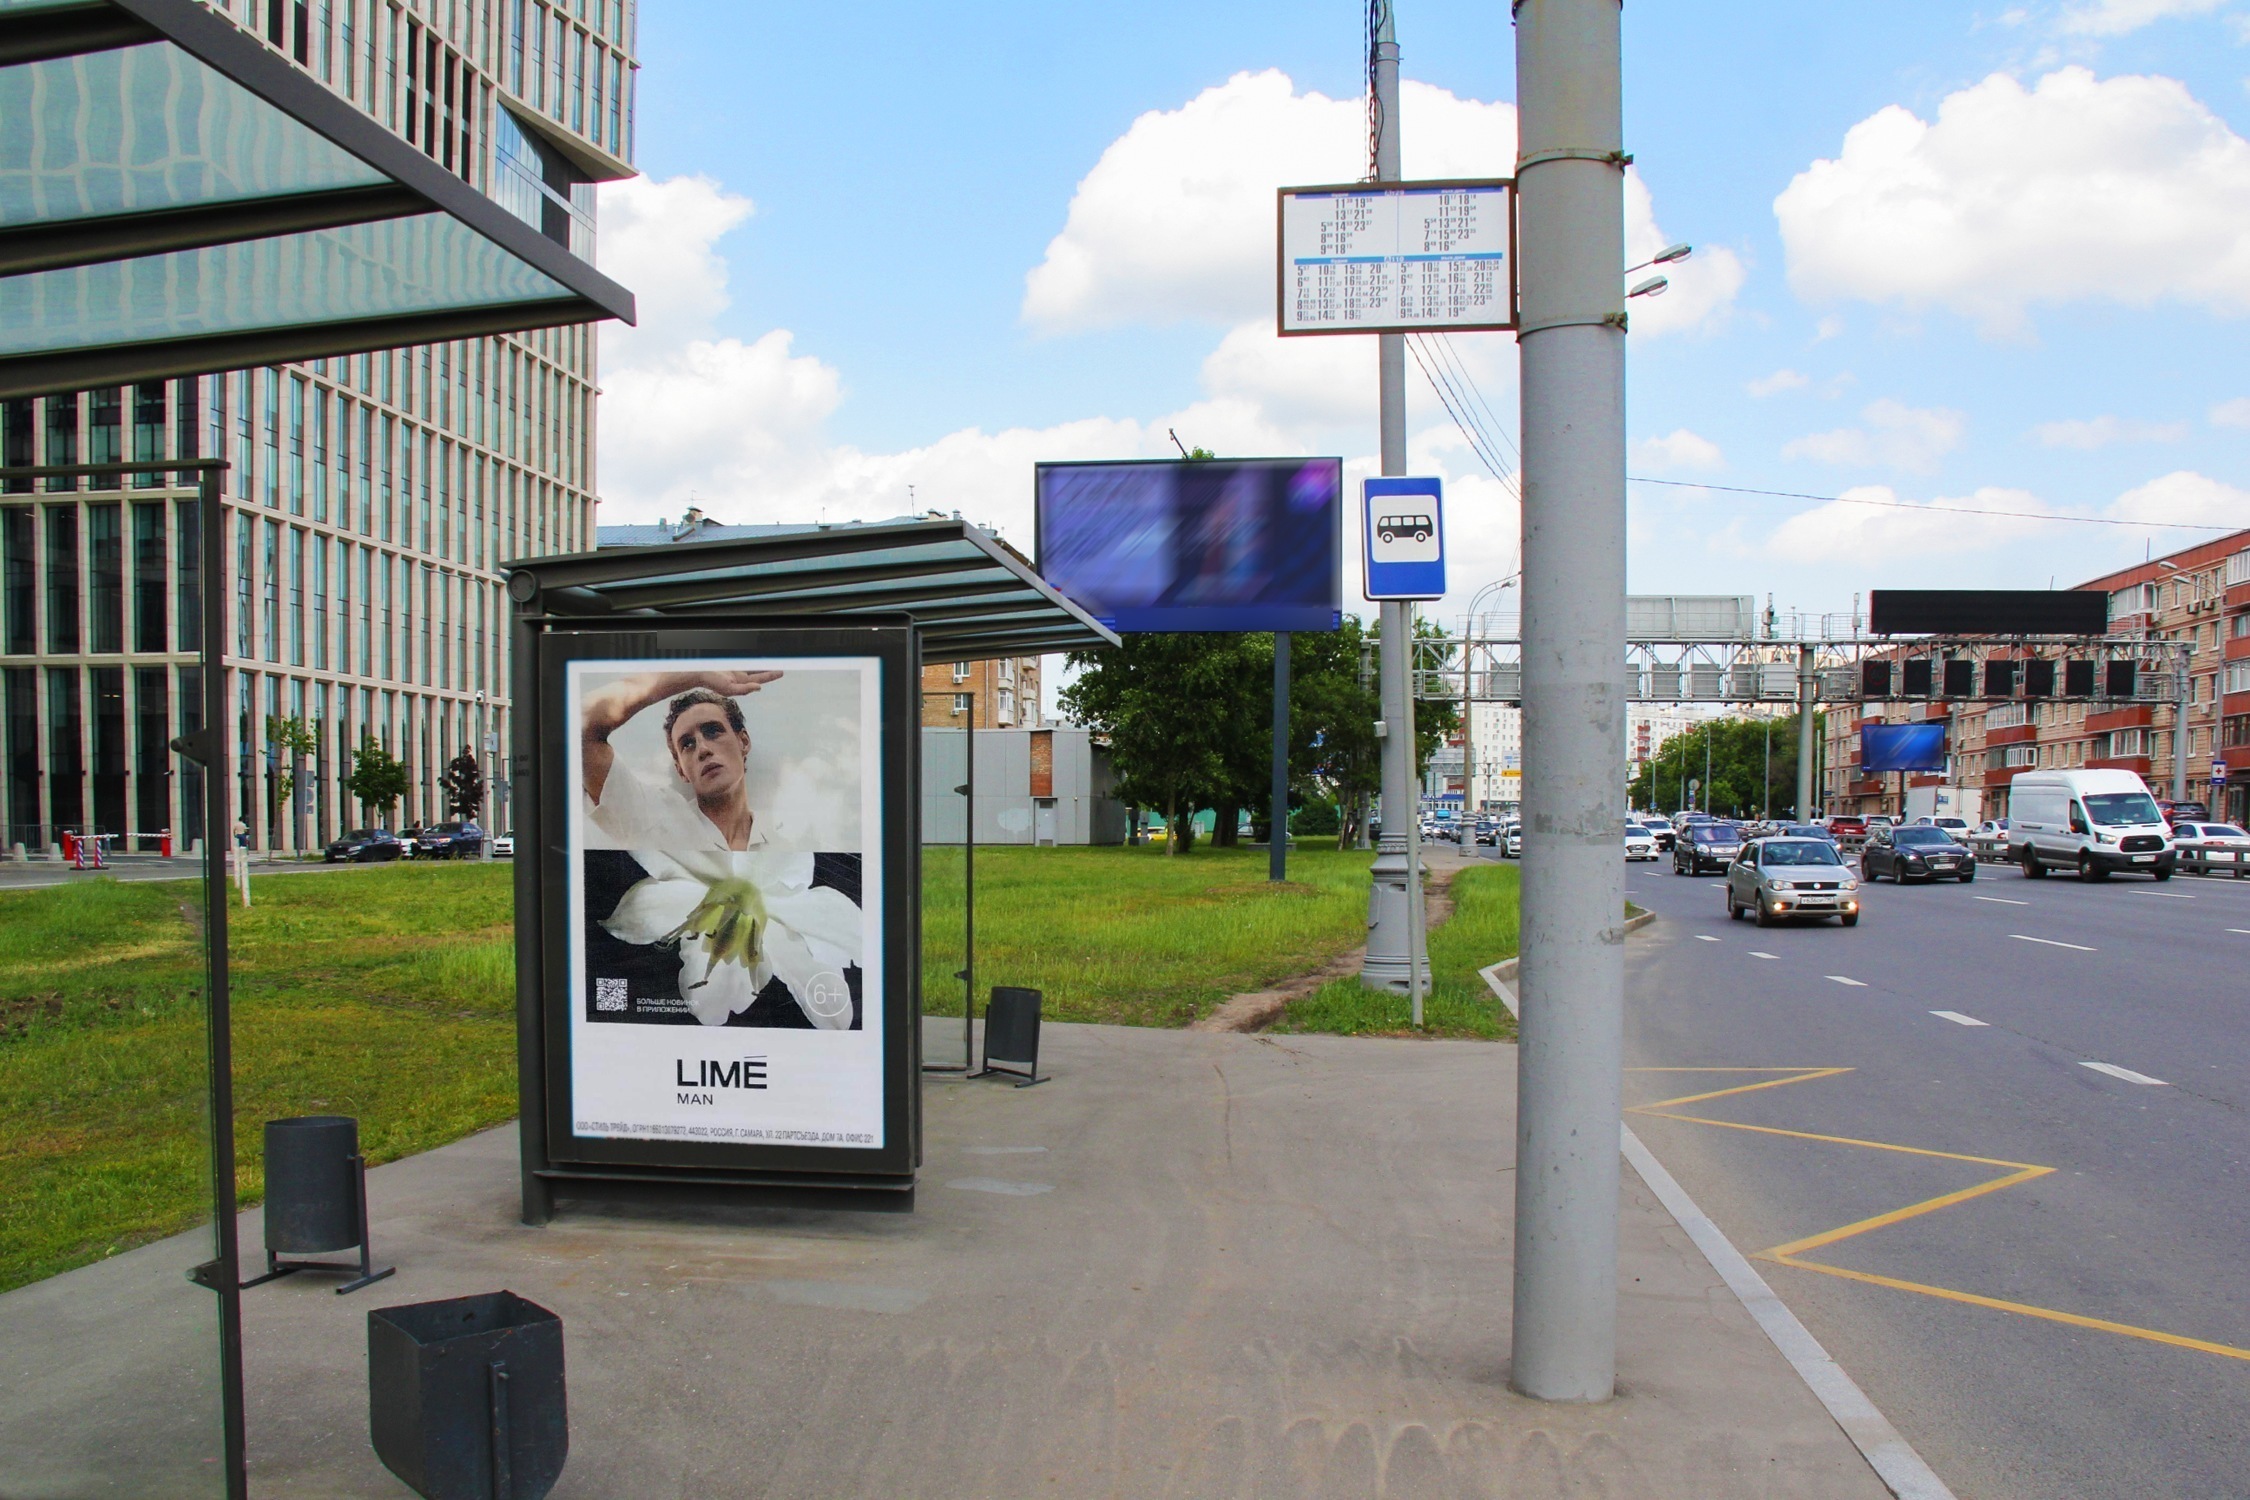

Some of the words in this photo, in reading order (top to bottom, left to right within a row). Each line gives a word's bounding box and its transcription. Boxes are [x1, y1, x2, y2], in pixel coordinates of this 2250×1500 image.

[1336, 199, 1344, 208] 11
[1355, 198, 1365, 208] 19
[1439, 195, 1449, 205] 10
[1459, 195, 1469, 204] 18
[1336, 210, 1346, 220] 13
[1354, 209, 1364, 219] 21
[1439, 207, 1448, 216] 11
[1459, 206, 1469, 216] 19
[1321, 222, 1326, 232] 5
[1336, 222, 1345, 231] 14
[1354, 221, 1365, 231] 23
[1424, 219, 1429, 229] 5
[1439, 218, 1449, 228] 13
[1458, 217, 1468, 227] 21
[1321, 233, 1326, 243] 8
[1335, 233, 1345, 243] 16
[1424, 230, 1429, 240] 7
[1439, 229, 1449, 240] 15
[1458, 229, 1469, 239] 23
[1321, 245, 1326, 255] 9
[1335, 244, 1345, 254] 18
[1424, 241, 1429, 251] 8
[1439, 241, 1449, 251] 16
[1298, 266, 1303, 276] 5
[1319, 265, 1329, 275] 10
[1345, 265, 1354, 274] 15
[1370, 264, 1381, 274] 20
[1401, 263, 1406, 273] 5
[1423, 262, 1432, 272] 10
[1449, 262, 1458, 271] 15
[1474, 261, 1485, 271] 20
[1298, 277, 1303, 287] 6
[1319, 277, 1327, 286] 11
[1344, 276, 1354, 285] 16
[1370, 275, 1380, 285] 21
[1401, 274, 1406, 284] 6
[1422, 274, 1431, 283] 11
[1449, 273, 1458, 283] 16
[1474, 272, 1484, 282] 21
[1298, 289, 1302, 298] 7
[1319, 288, 1328, 298] 12
[1344, 287, 1354, 297] 17
[1370, 286, 1380, 296] 22
[1401, 286, 1406, 295] 7
[1422, 285, 1432, 295] 12
[1449, 284, 1458, 294] 17
[1474, 284, 1485, 294] 22
[1297, 300, 1302, 309] 8
[1318, 299, 1328, 309] 13
[1344, 298, 1354, 308] 18
[1370, 298, 1380, 308] 23
[1401, 297, 1406, 307] 8
[1422, 296, 1432, 306] 13
[1449, 296, 1458, 306] 18
[1474, 295, 1485, 305] 23
[1297, 311, 1302, 321] 9
[1318, 310, 1328, 320] 14
[1344, 310, 1354, 320] 19
[1401, 308, 1406, 318] 9
[1422, 308, 1432, 318] 14
[1449, 307, 1458, 317] 19
[813, 983, 843, 1005] 6+
[677, 1093, 713, 1105] MAN
